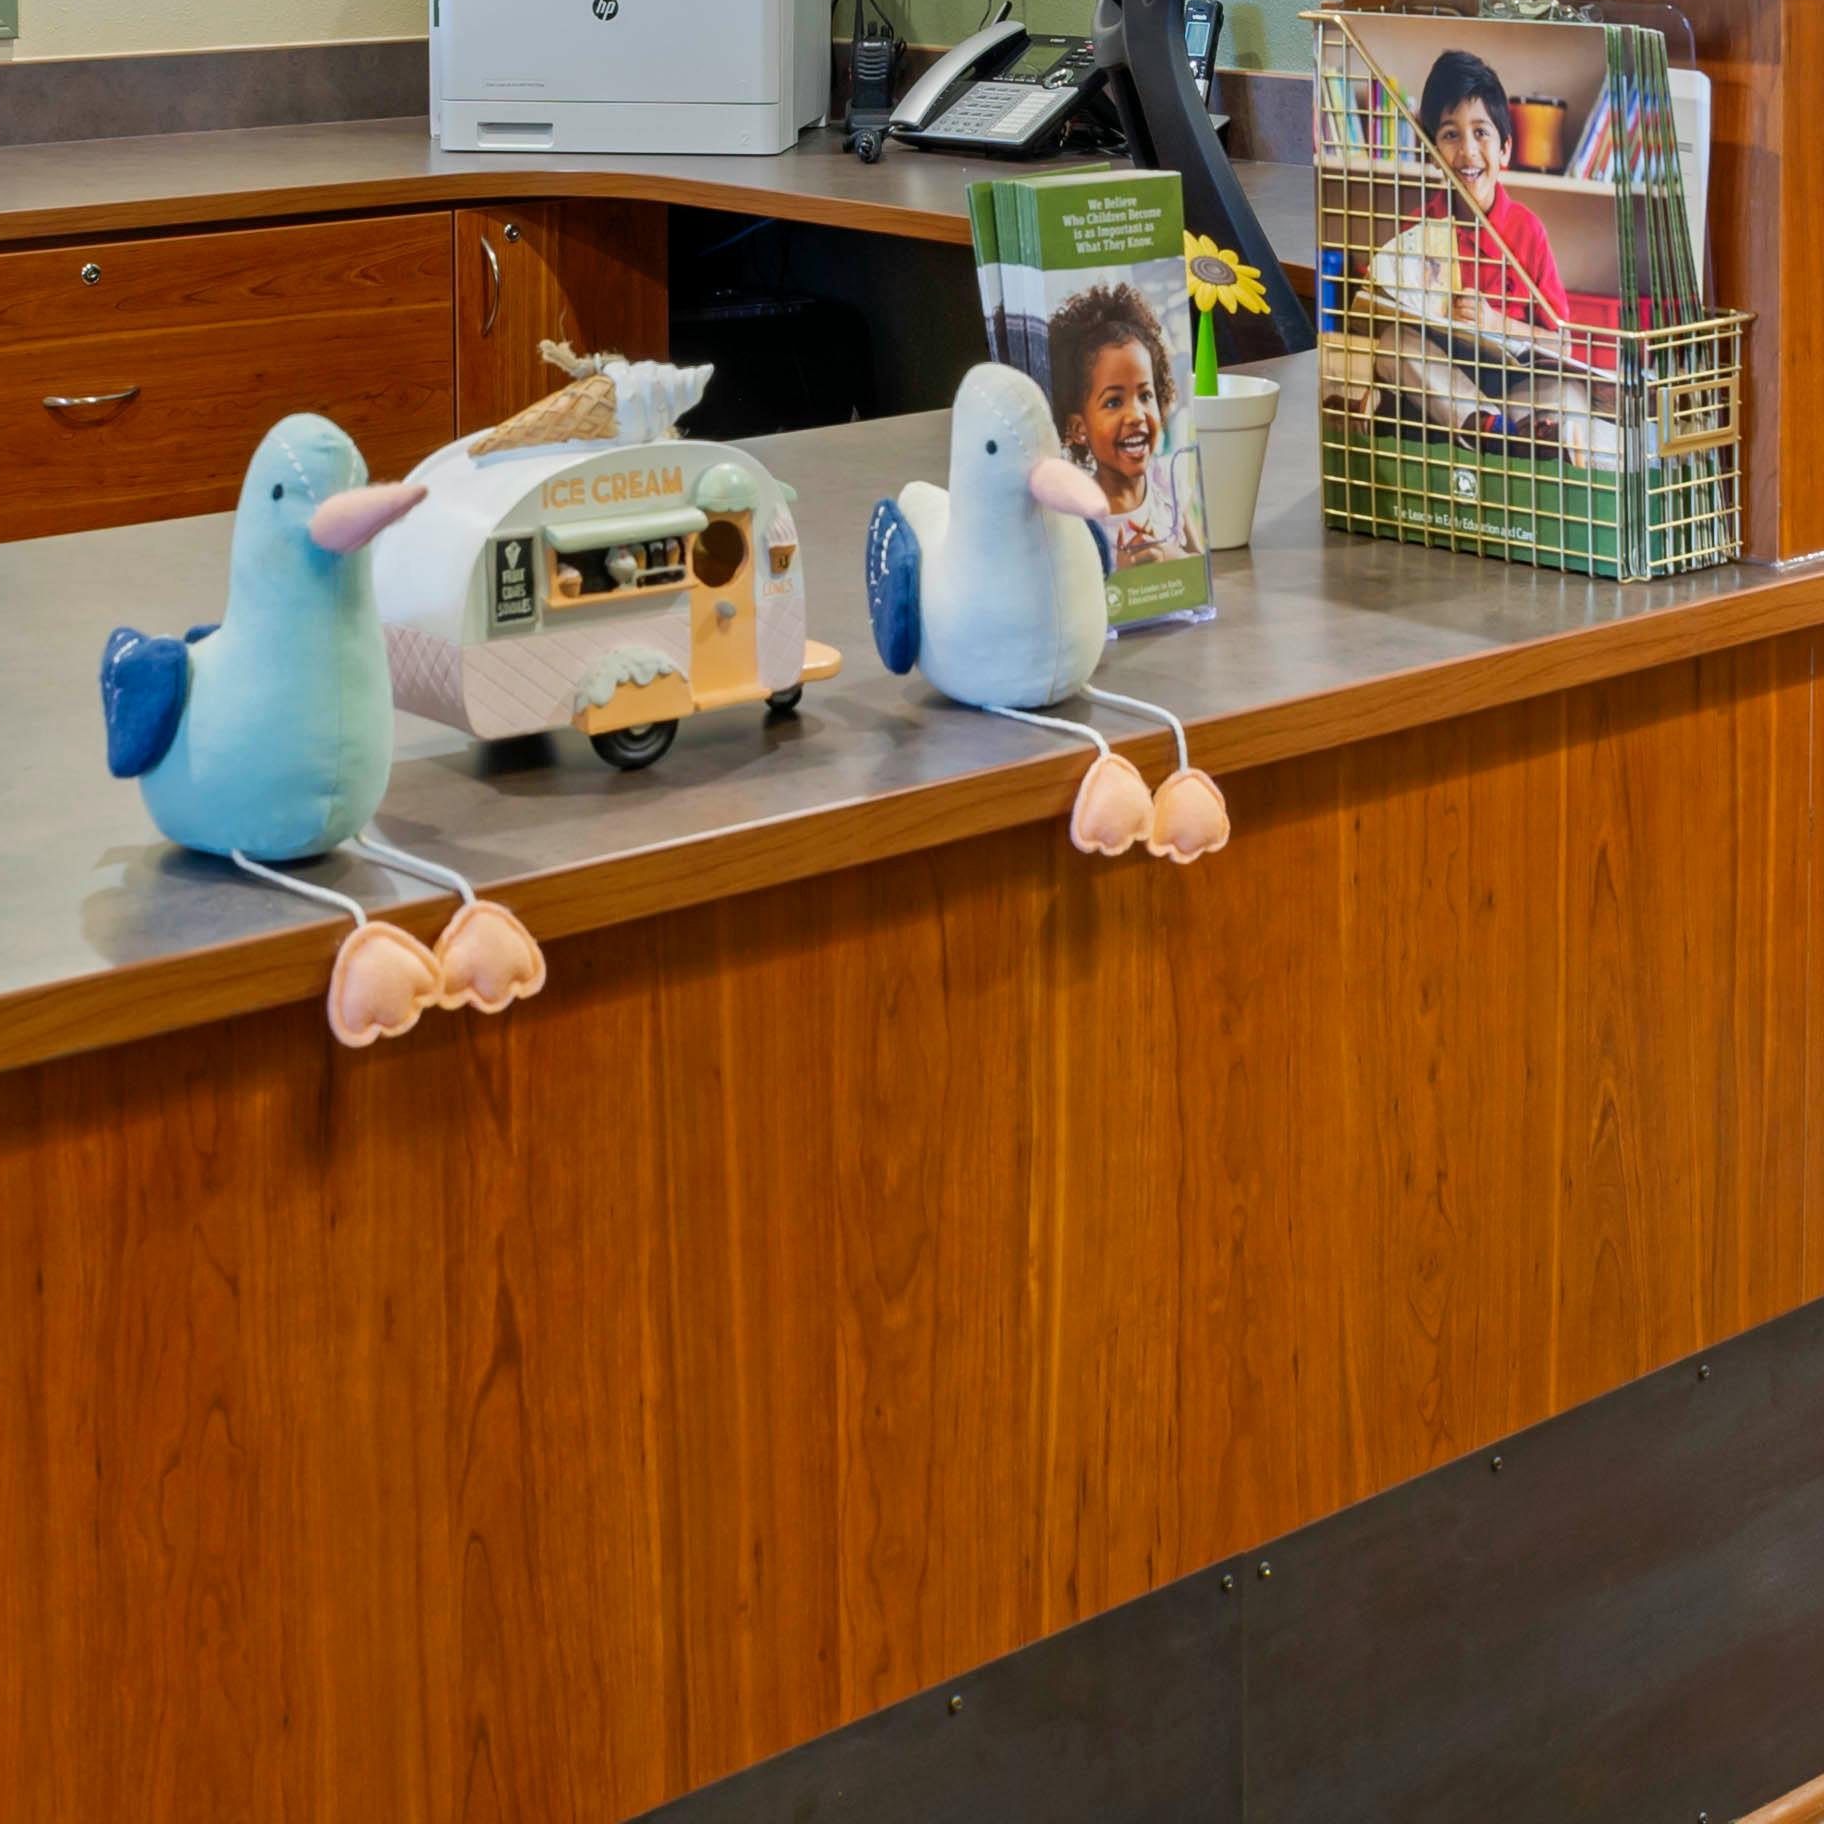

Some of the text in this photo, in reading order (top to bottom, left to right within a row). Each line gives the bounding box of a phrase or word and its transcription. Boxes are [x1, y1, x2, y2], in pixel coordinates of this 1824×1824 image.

[1088, 197, 1137, 210] We Believe
[1062, 208, 1162, 227] Who Children Become
[1073, 229, 1082, 240] is
[1084, 228, 1095, 238] as
[1144, 223, 1154, 232] as
[1076, 237, 1154, 254] What They Know.
[542, 466, 684, 510] ICE CREAM
